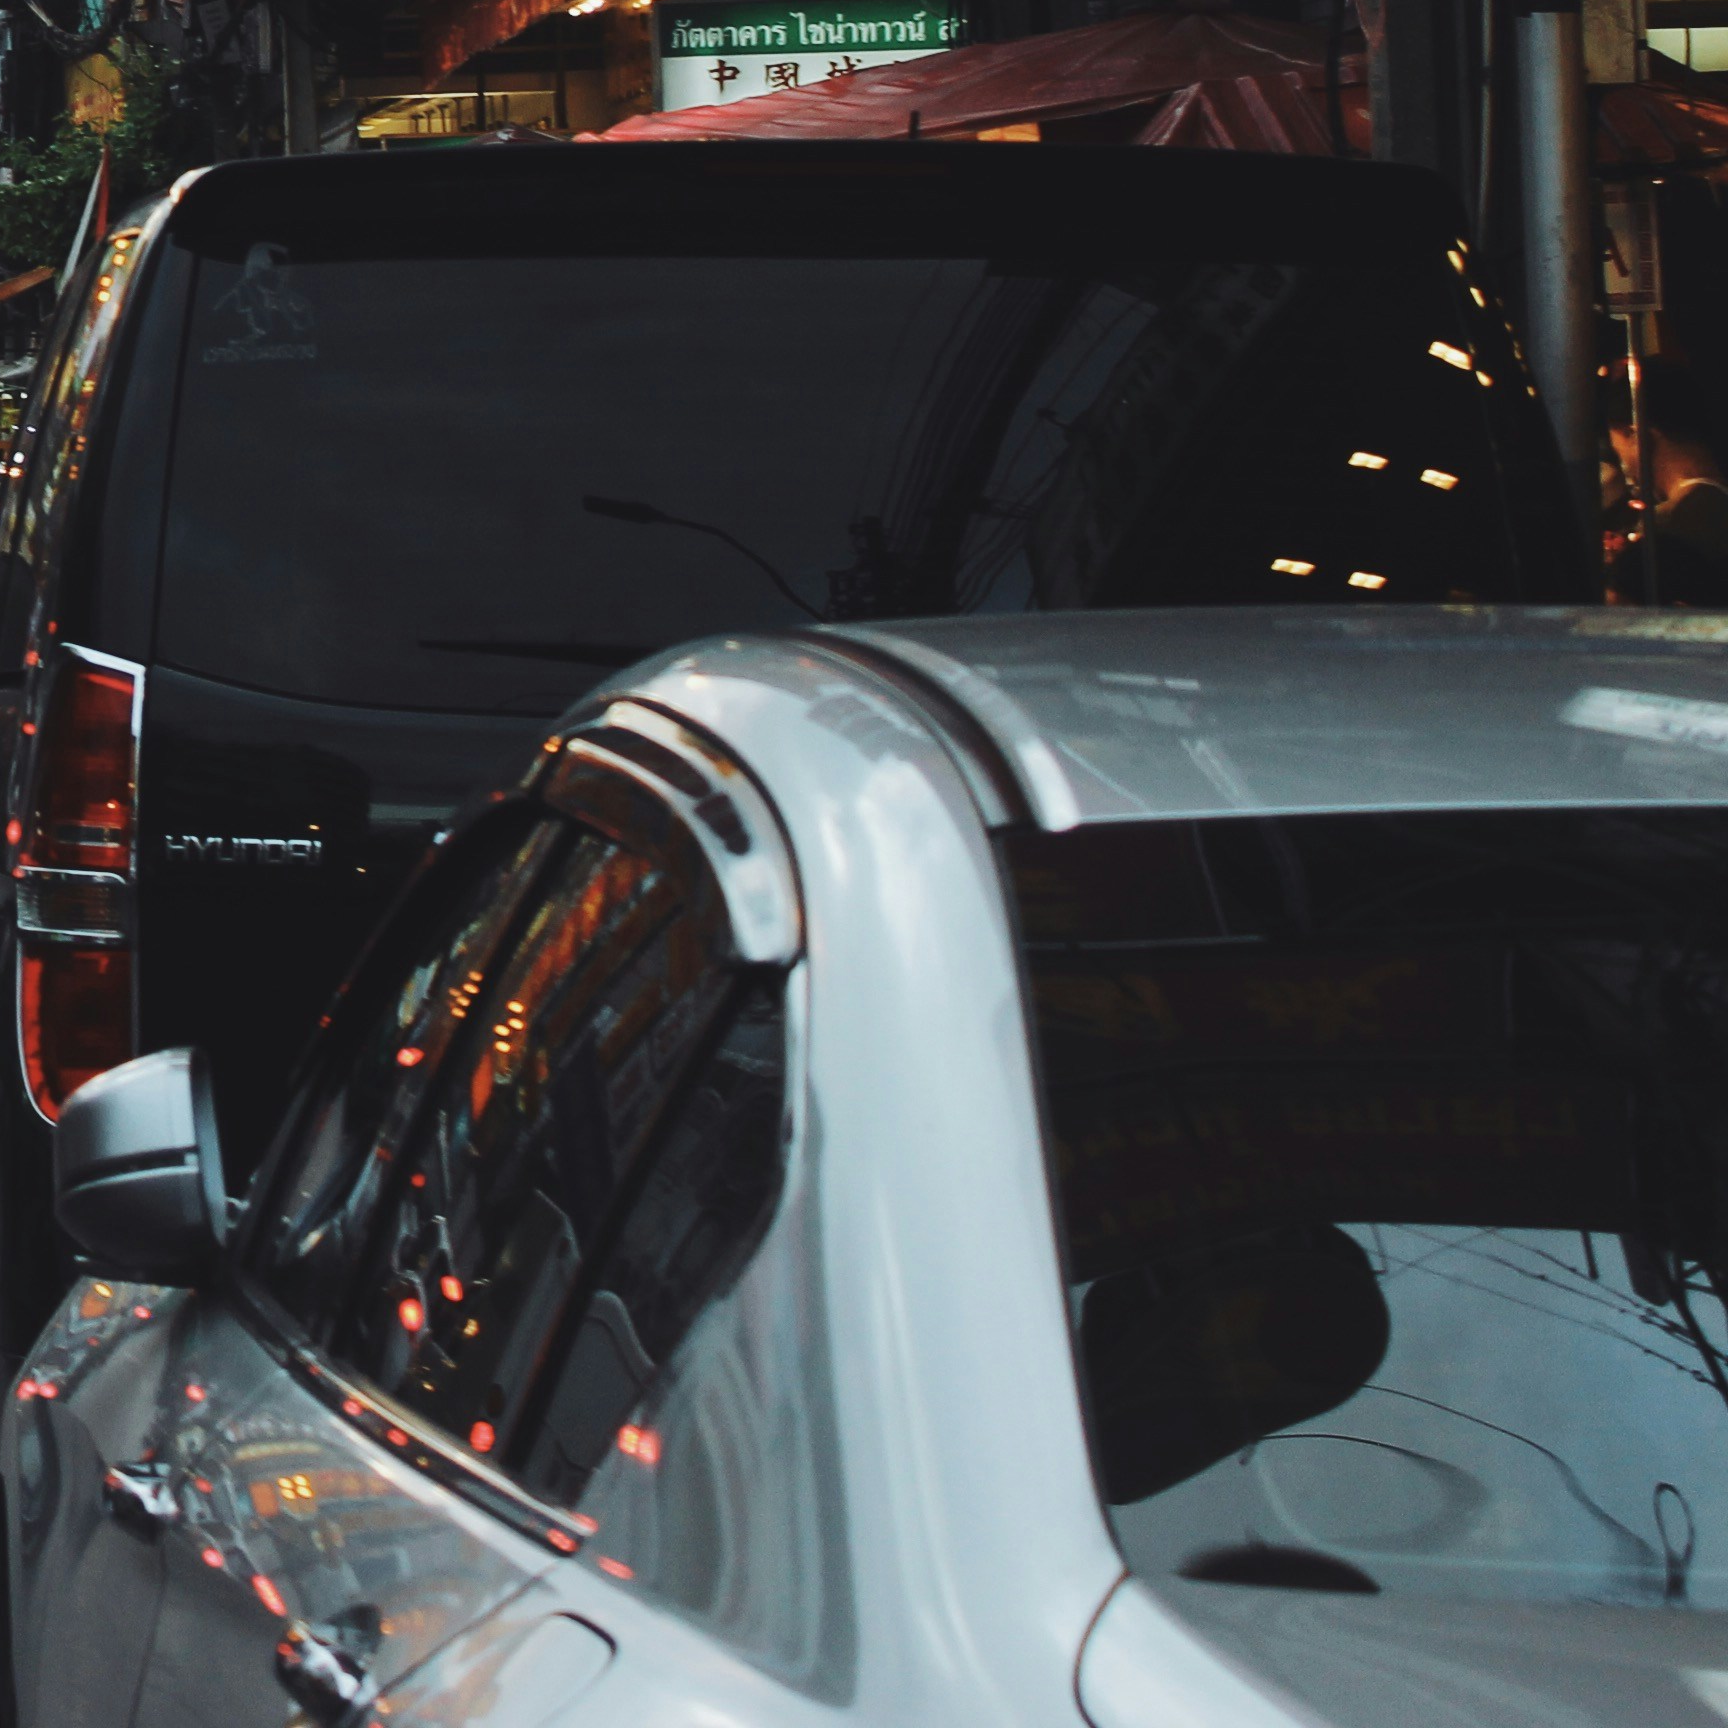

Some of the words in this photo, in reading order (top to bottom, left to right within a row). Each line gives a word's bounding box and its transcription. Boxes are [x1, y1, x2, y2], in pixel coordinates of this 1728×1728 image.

[671, 19, 787, 49] ภัตตาคาร
[789, 10, 927, 46] ไชน่าทาวน์
[165, 833, 322, 864] HYUNDAI
